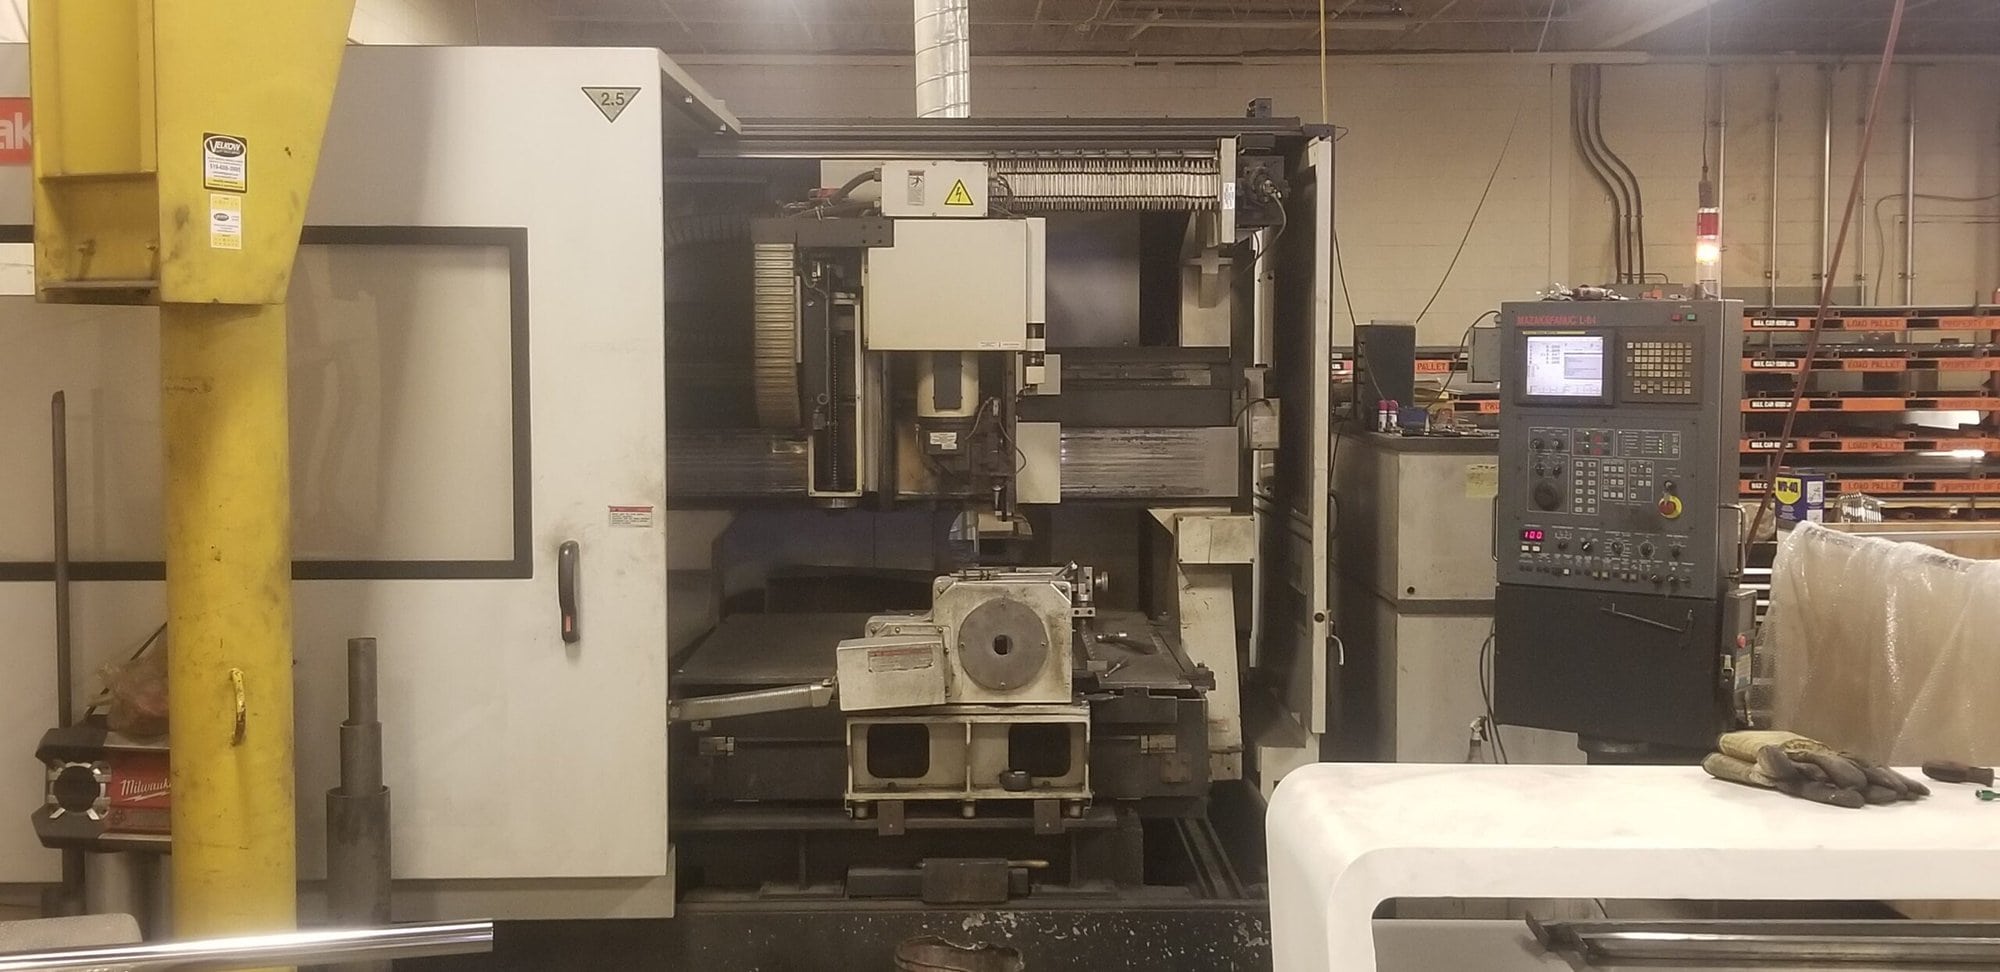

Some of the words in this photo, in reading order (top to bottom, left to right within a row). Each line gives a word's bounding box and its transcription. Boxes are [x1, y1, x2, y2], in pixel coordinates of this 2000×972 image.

[601, 92, 625, 106] 2.5
[1870, 319, 1900, 328] PALLET
[1417, 362, 1446, 371] PALLET
[1870, 360, 1900, 369] PALLET
[1871, 482, 1901, 491] PALLET
[1525, 531, 1542, 539] 100
